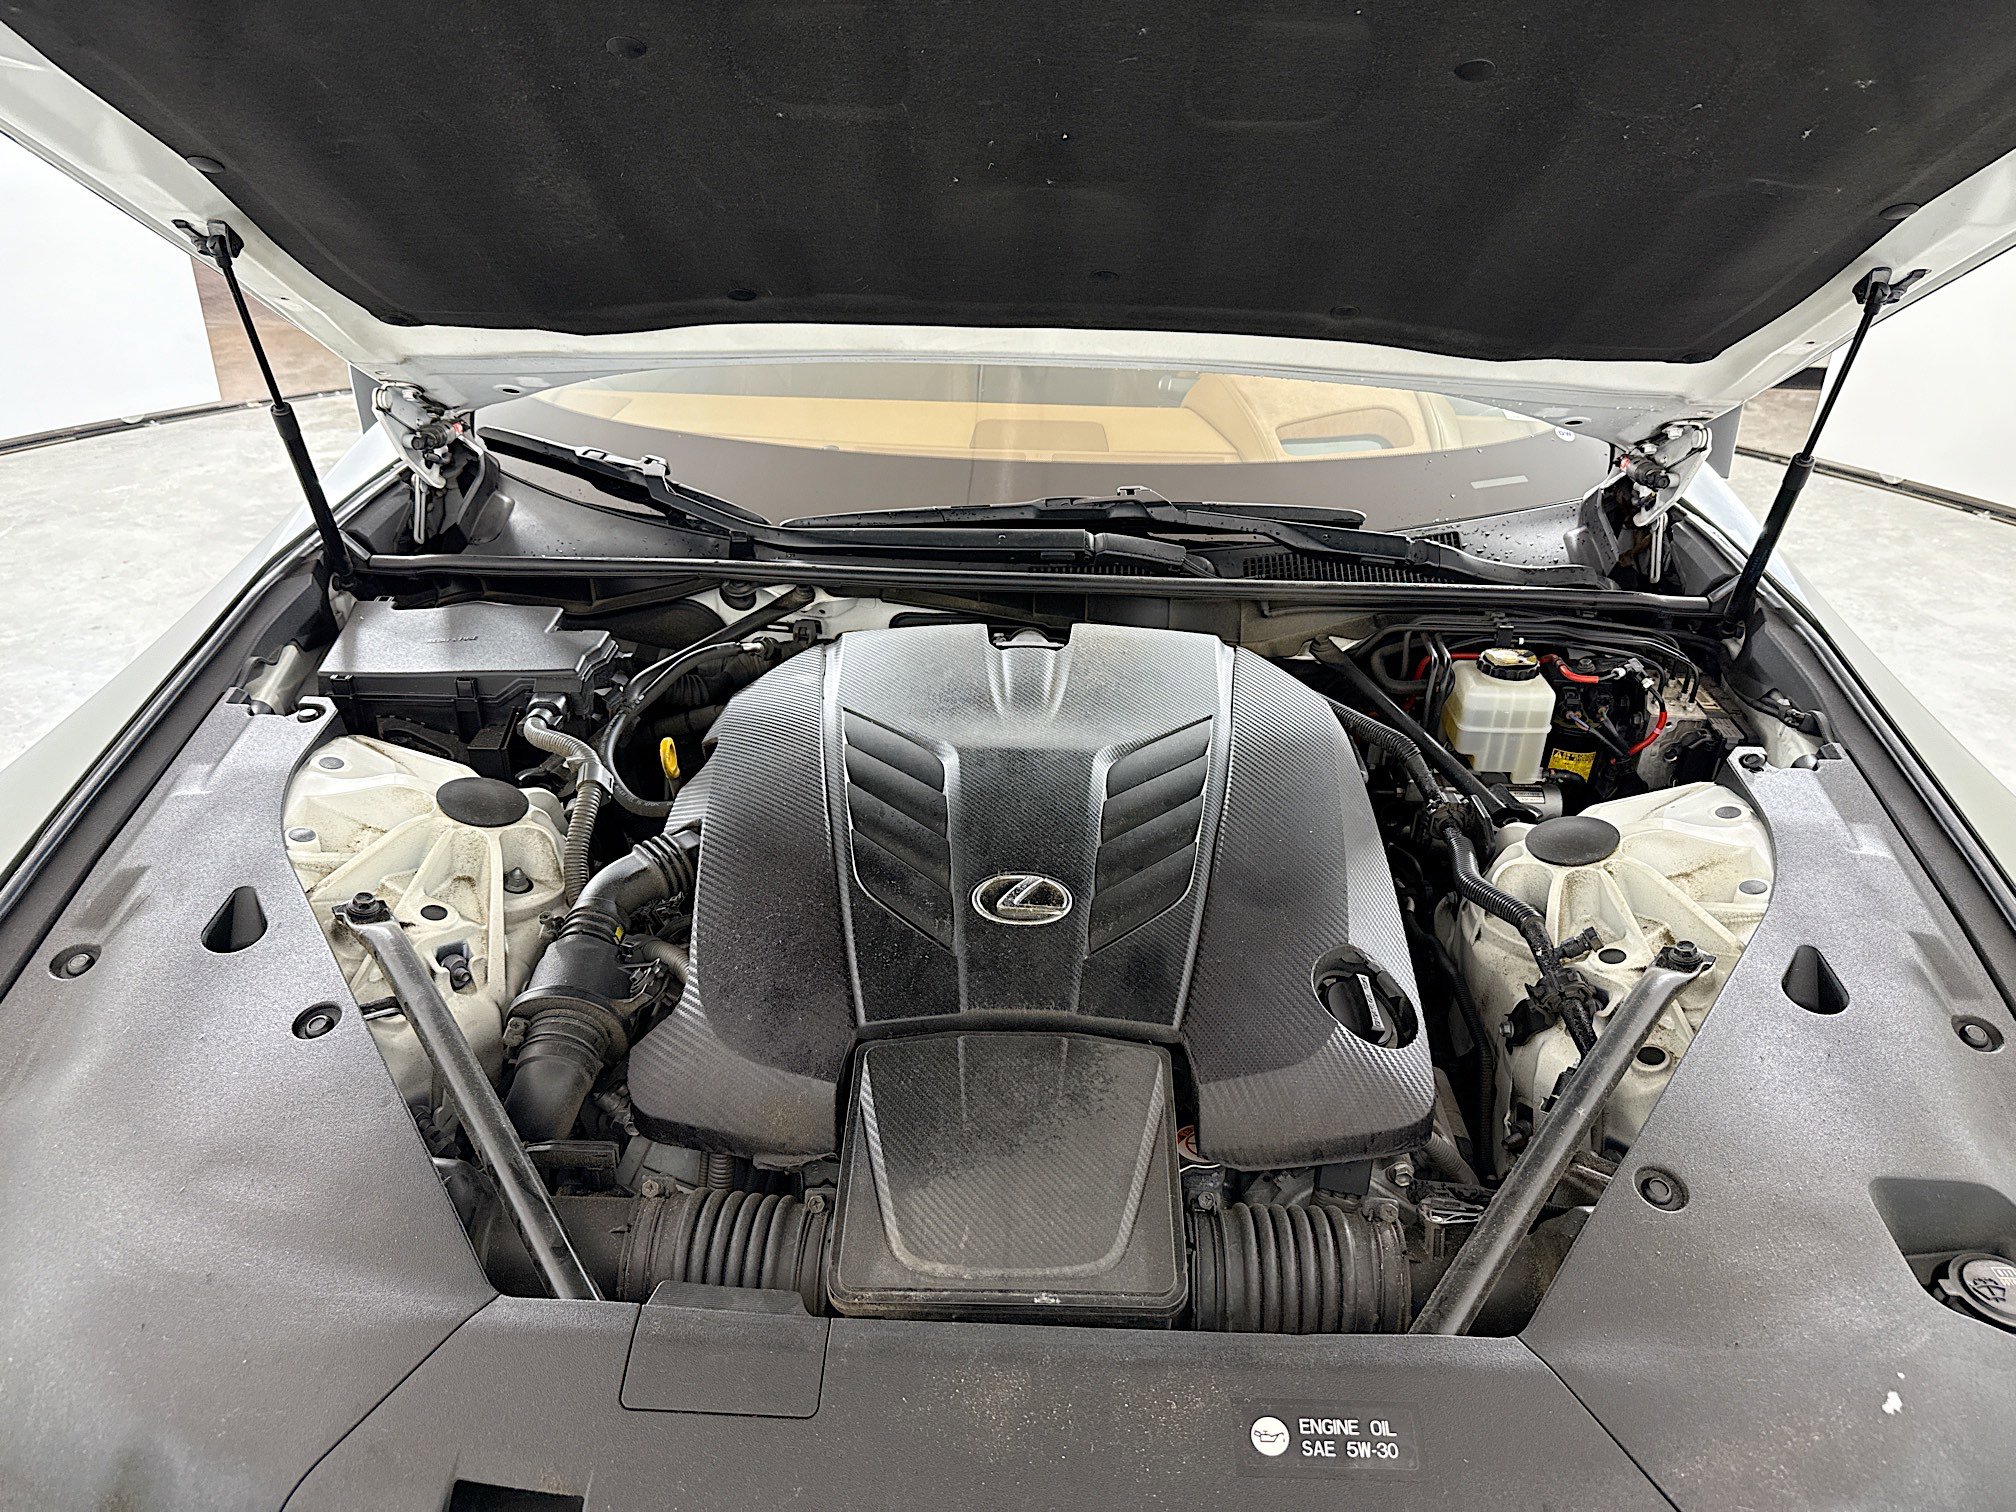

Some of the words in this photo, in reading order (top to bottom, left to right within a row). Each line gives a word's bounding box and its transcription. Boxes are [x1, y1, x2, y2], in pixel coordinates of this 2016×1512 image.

[1299, 1419, 1361, 1436] ENGINE
[1370, 1421, 1398, 1437] OIL
[1302, 1440, 1337, 1458] SAE
[1346, 1442, 1400, 1459] 5W-30
